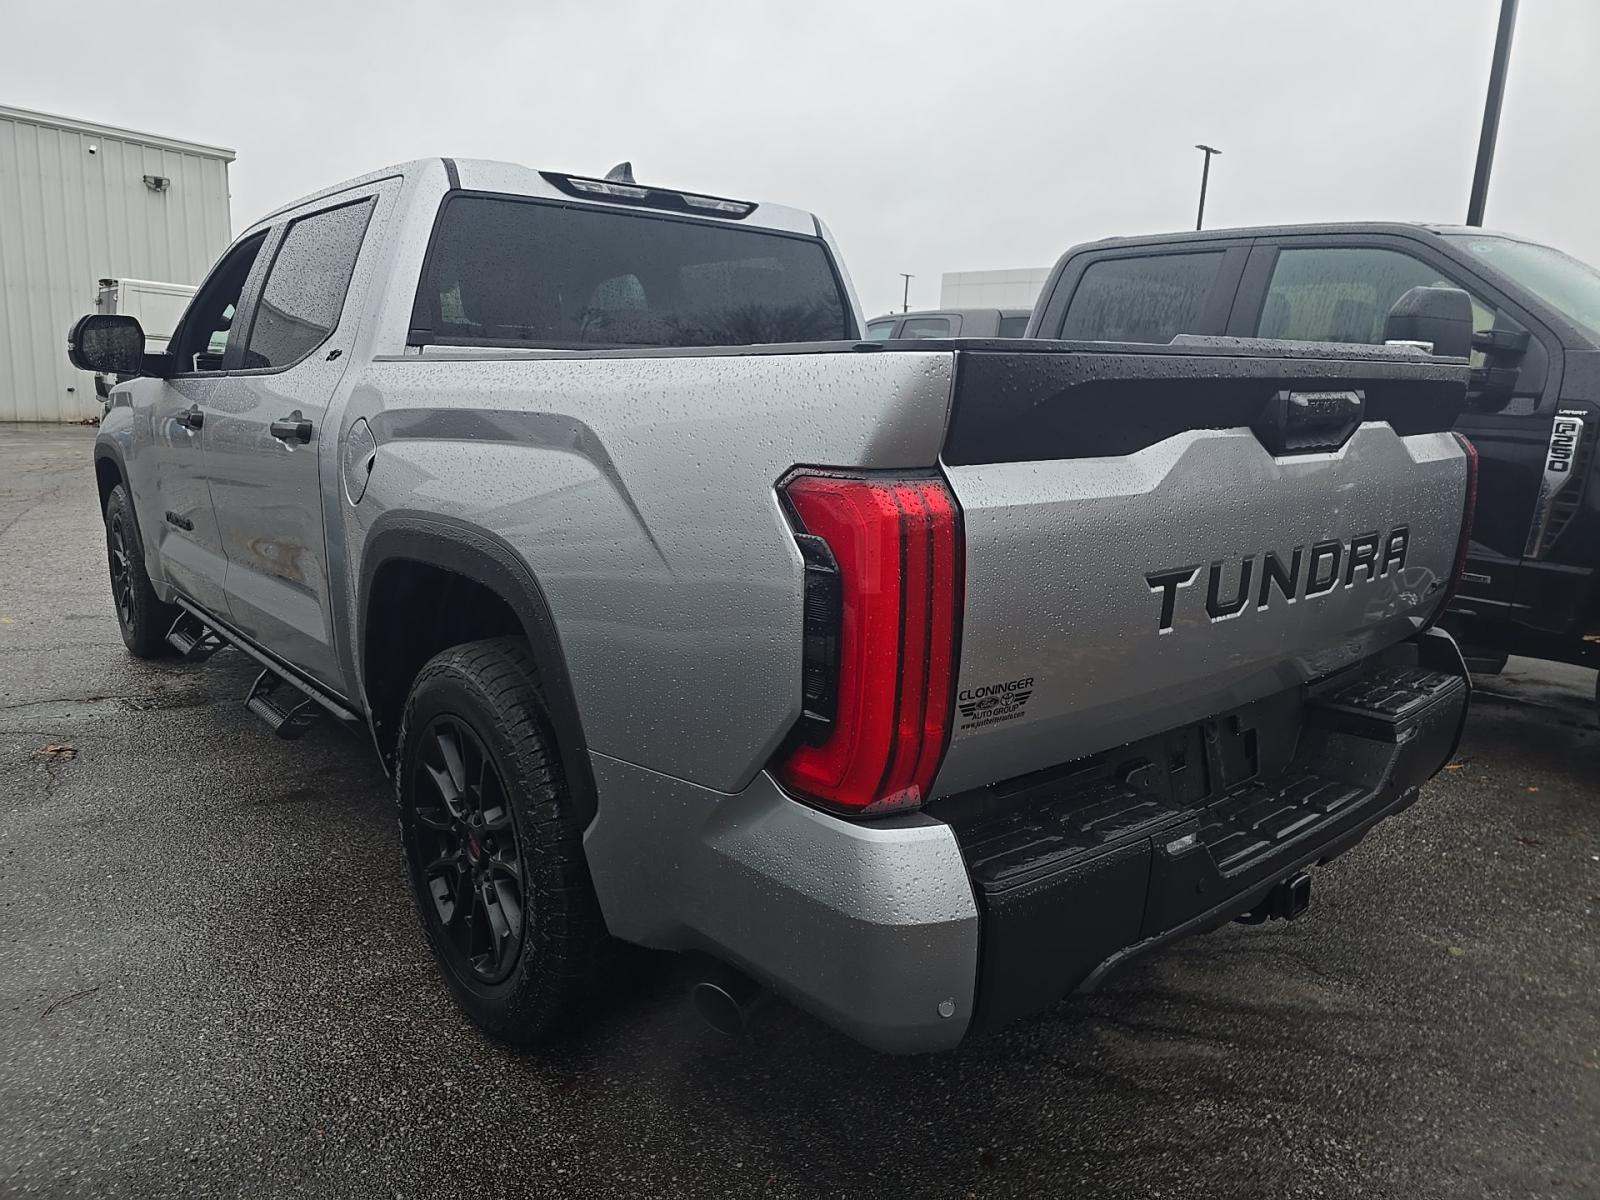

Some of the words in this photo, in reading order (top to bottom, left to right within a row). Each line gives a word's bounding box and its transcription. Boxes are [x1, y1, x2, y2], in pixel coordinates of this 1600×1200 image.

[1547, 422, 1577, 472] F250
[1145, 523, 1410, 636] TUNDRA
[958, 677, 1034, 701] CLONINGER
[971, 710, 993, 721] AUTO
[993, 702, 1020, 716] GROUP
